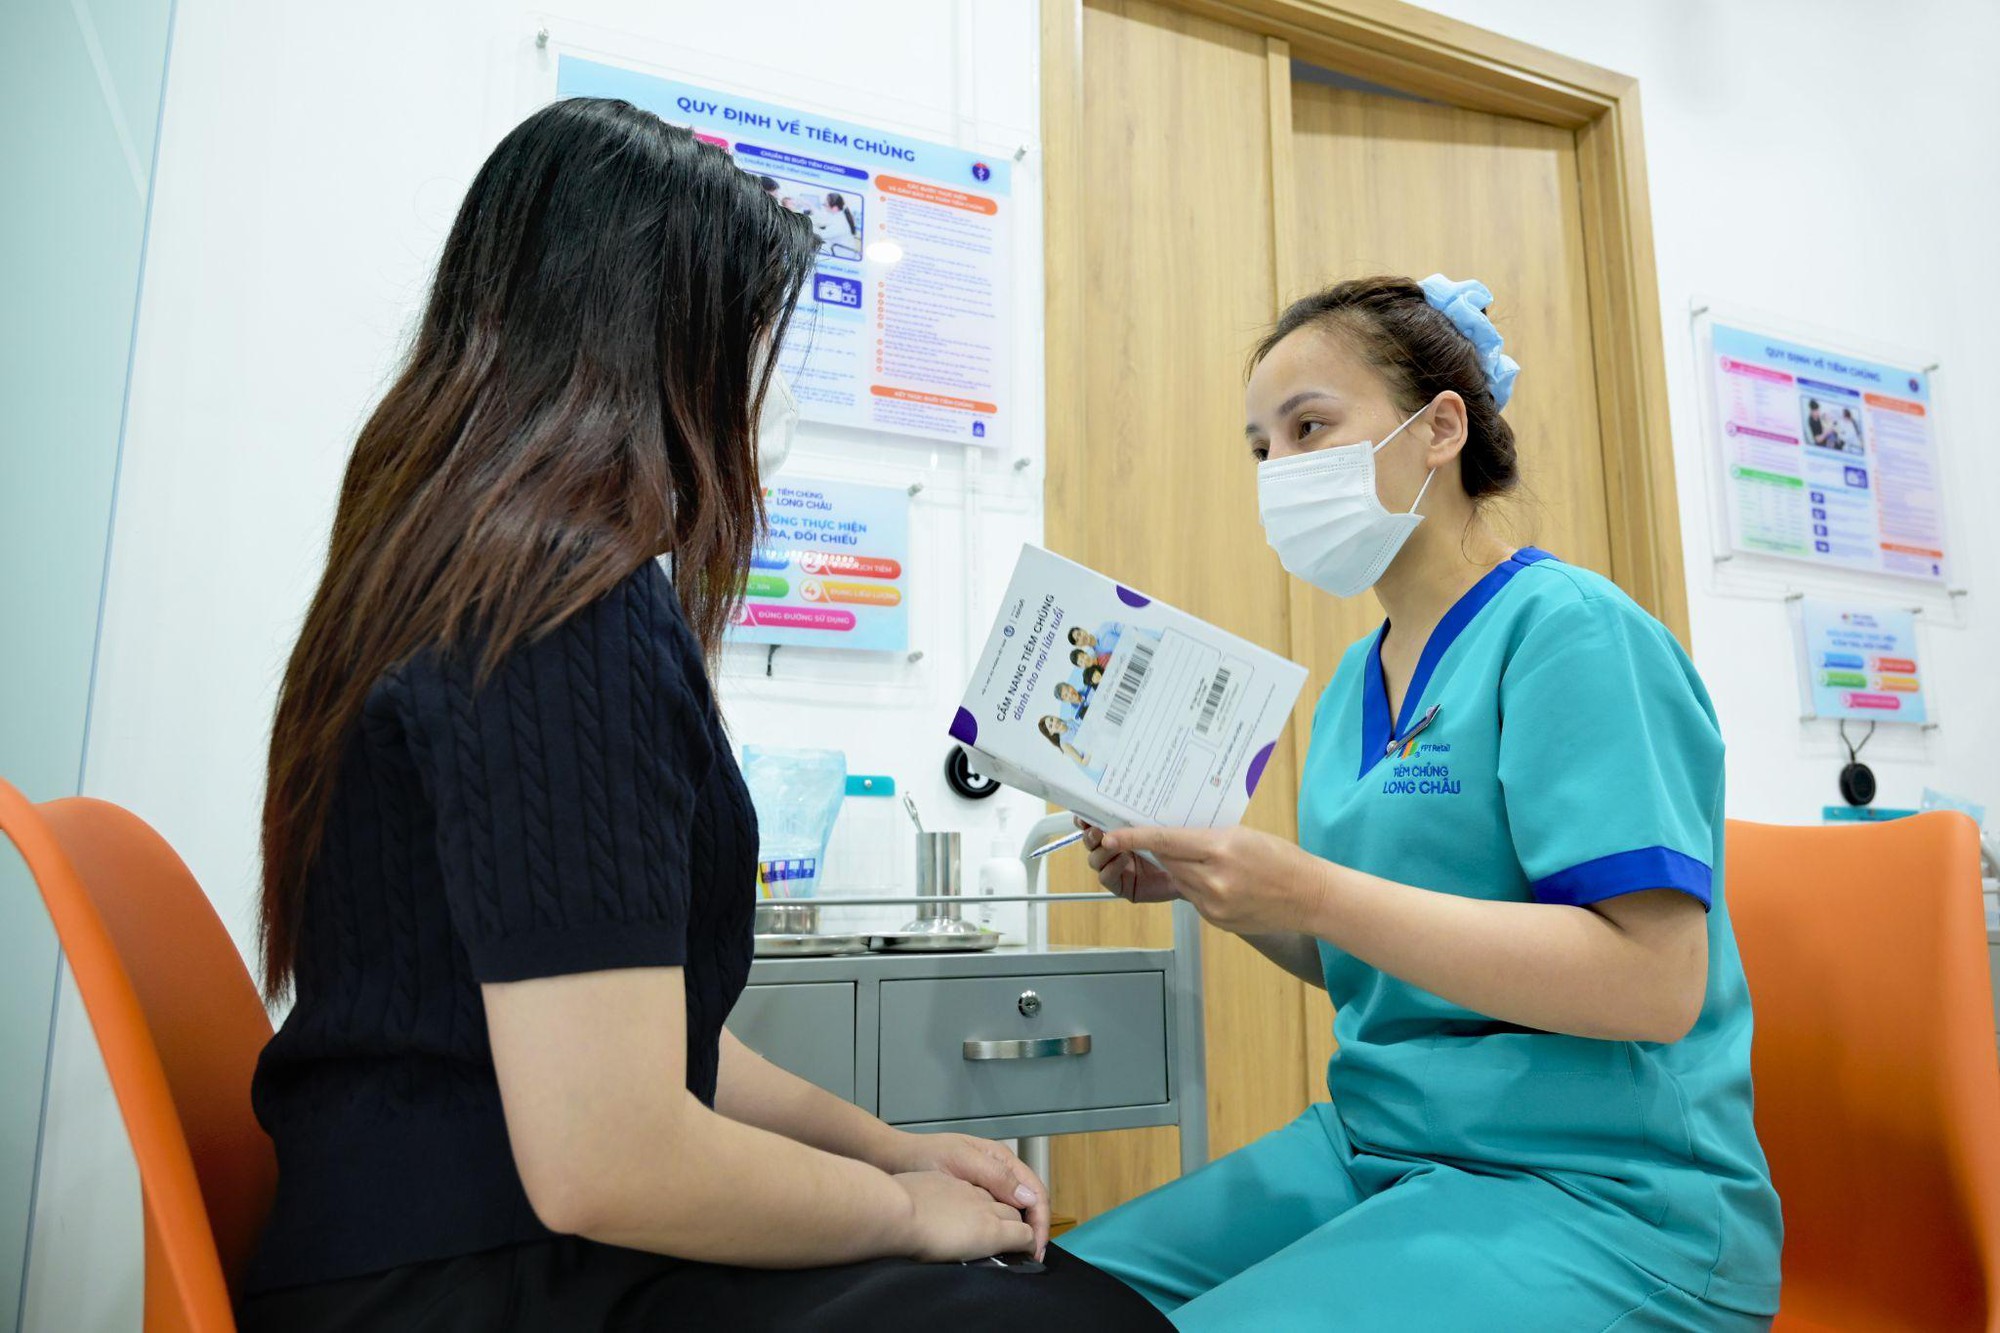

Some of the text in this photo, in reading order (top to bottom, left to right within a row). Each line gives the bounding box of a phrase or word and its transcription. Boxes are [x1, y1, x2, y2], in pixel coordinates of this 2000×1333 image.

[677, 96, 718, 116] QUY
[723, 106, 771, 128] ĐỊNH
[805, 126, 848, 147] TIÊM
[853, 137, 916, 162] CHỦNG
[777, 498, 832, 511] LONG CHÂU
[769, 528, 791, 540] RA,
[804, 582, 816, 596] 4
[997, 593, 1055, 722] CẨM NANG TIÊM CHỦNG
[1013, 606, 1065, 721] dành cho mọi lứa tuổi
[1421, 743, 1451, 752] FPT Retail
[1393, 761, 1449, 778] TIÊM CHỦNG
[1383, 777, 1461, 794] LONG CHÂU
